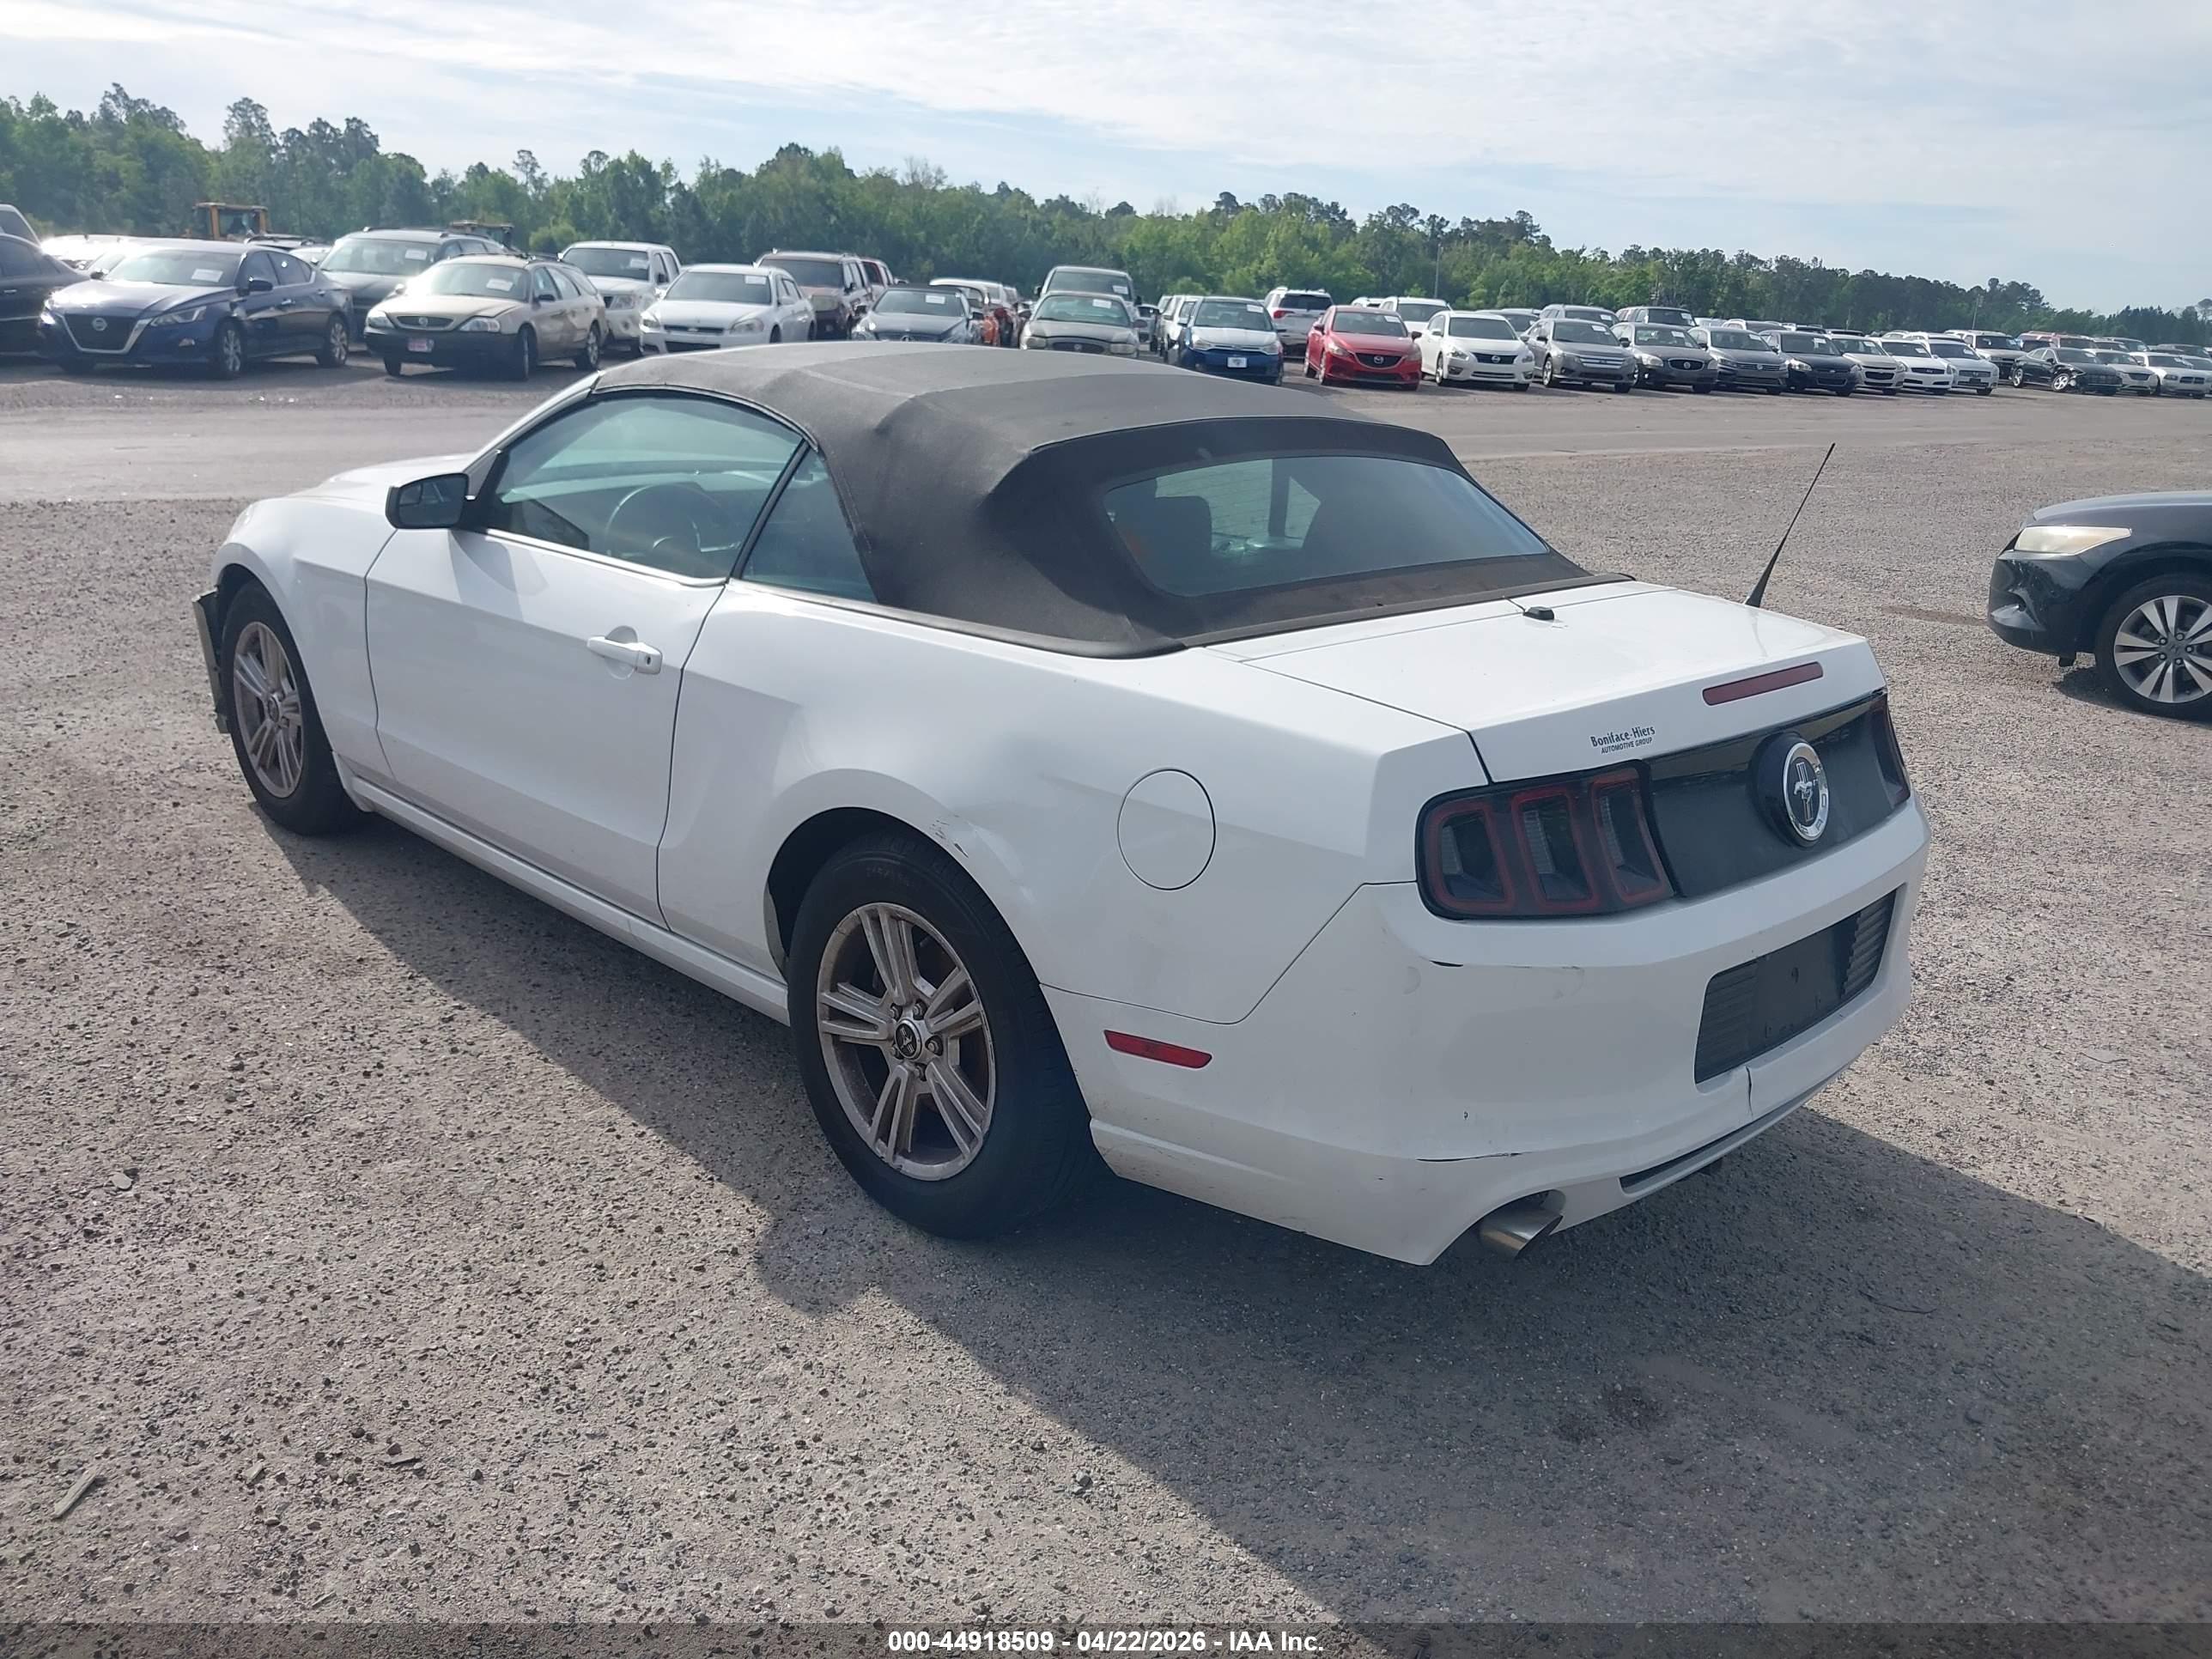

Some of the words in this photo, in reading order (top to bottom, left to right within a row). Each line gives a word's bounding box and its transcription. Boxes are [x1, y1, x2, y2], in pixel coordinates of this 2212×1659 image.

[1590, 726, 1656, 747] Boniface-Hiers
[1601, 740, 1635, 754] AUTOMOTIVE
[1635, 737, 1653, 746] GROUP
